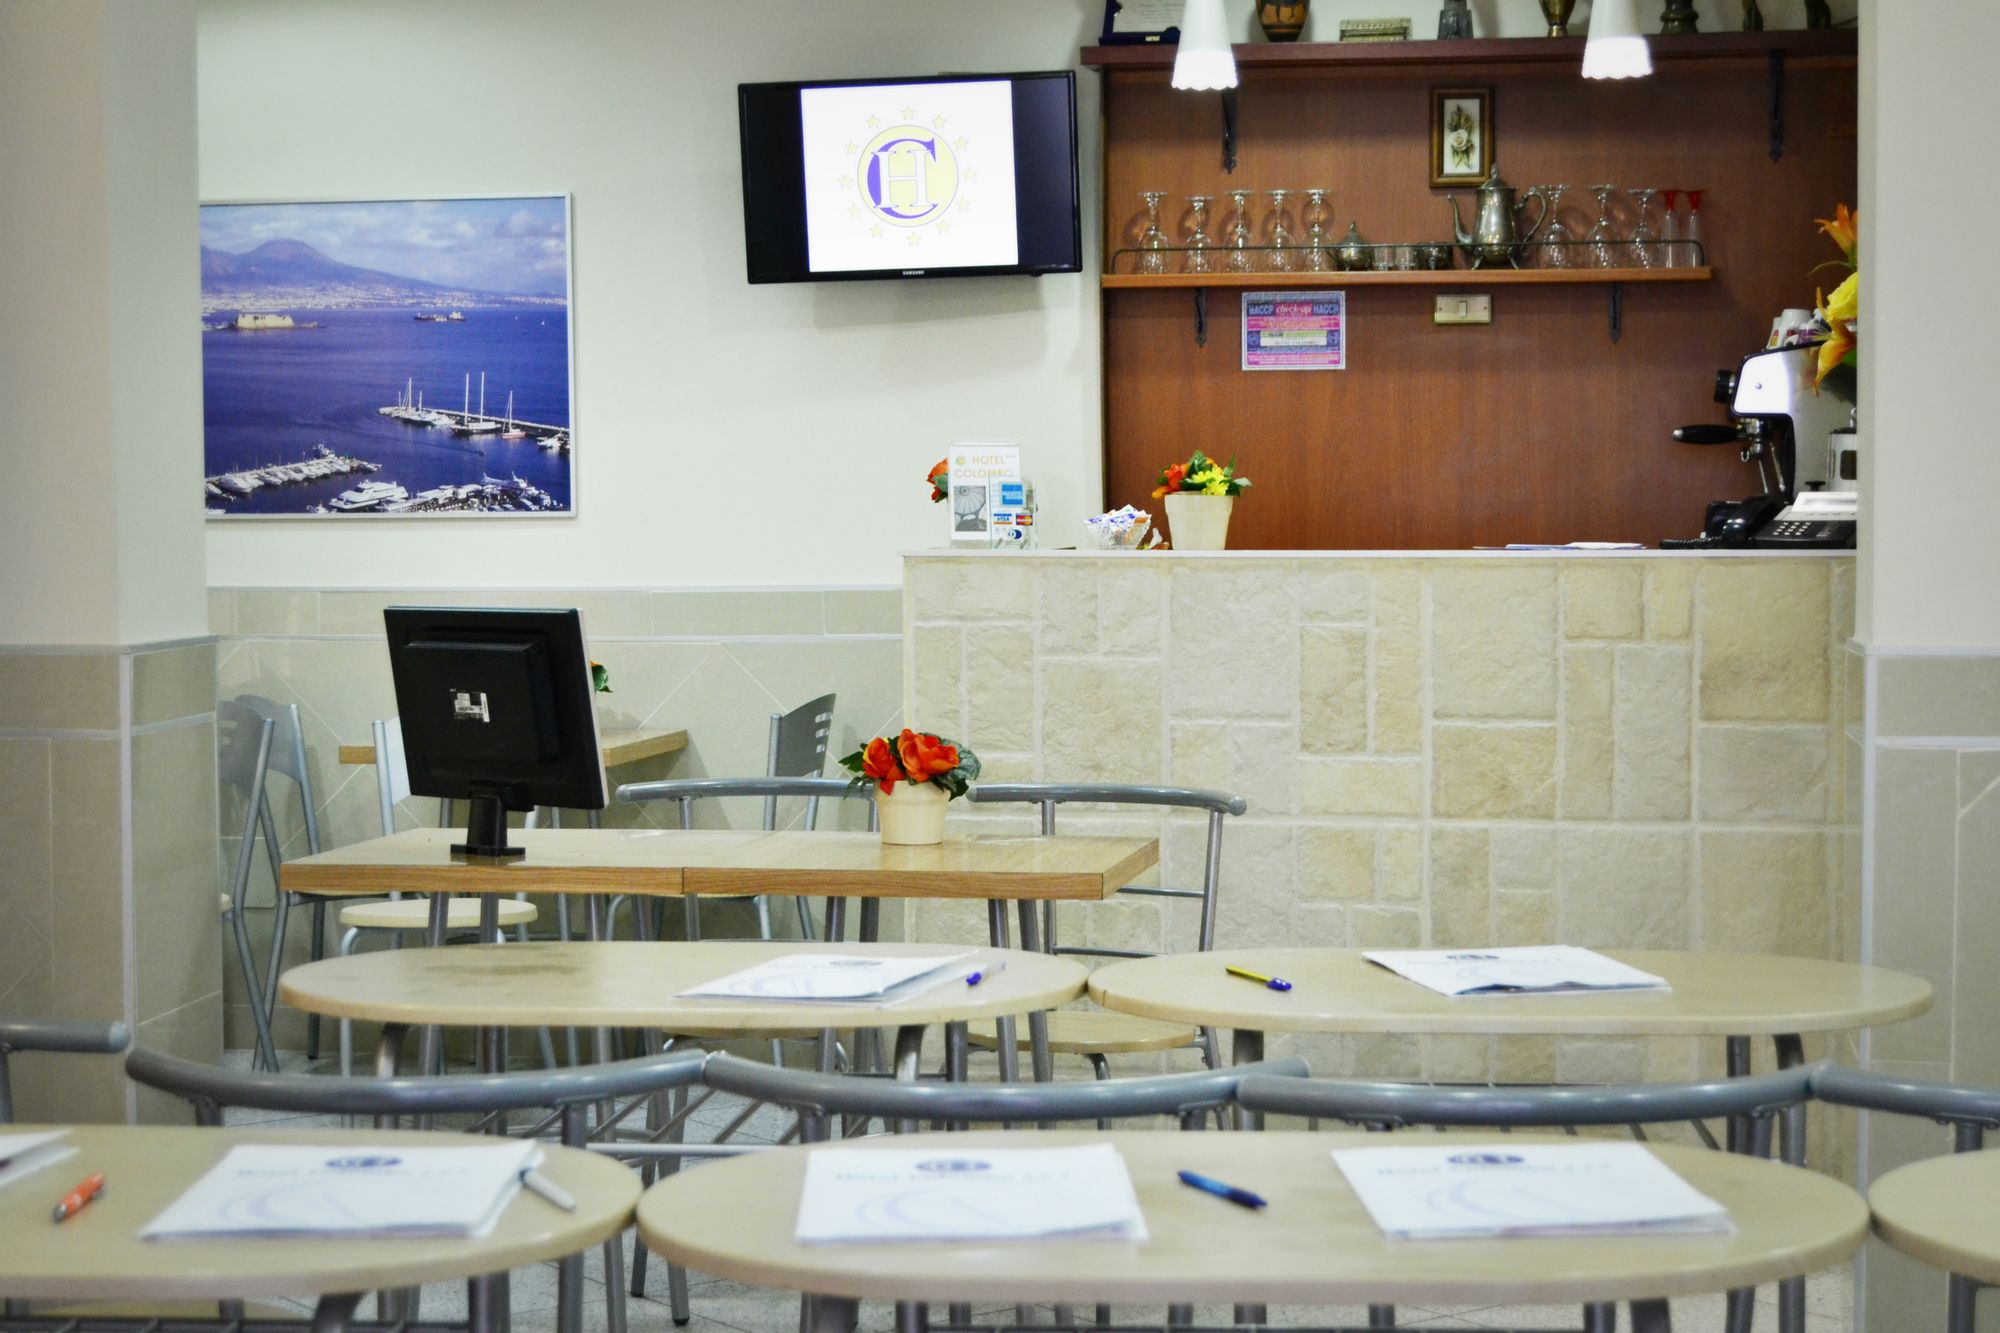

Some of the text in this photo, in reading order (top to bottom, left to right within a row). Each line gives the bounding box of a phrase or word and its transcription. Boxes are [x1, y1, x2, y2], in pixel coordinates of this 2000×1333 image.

[1248, 303, 1339, 315] HACCP check-up HACCP
[972, 455, 1005, 465] HOTEL
[954, 468, 1014, 478] COLOMBO
